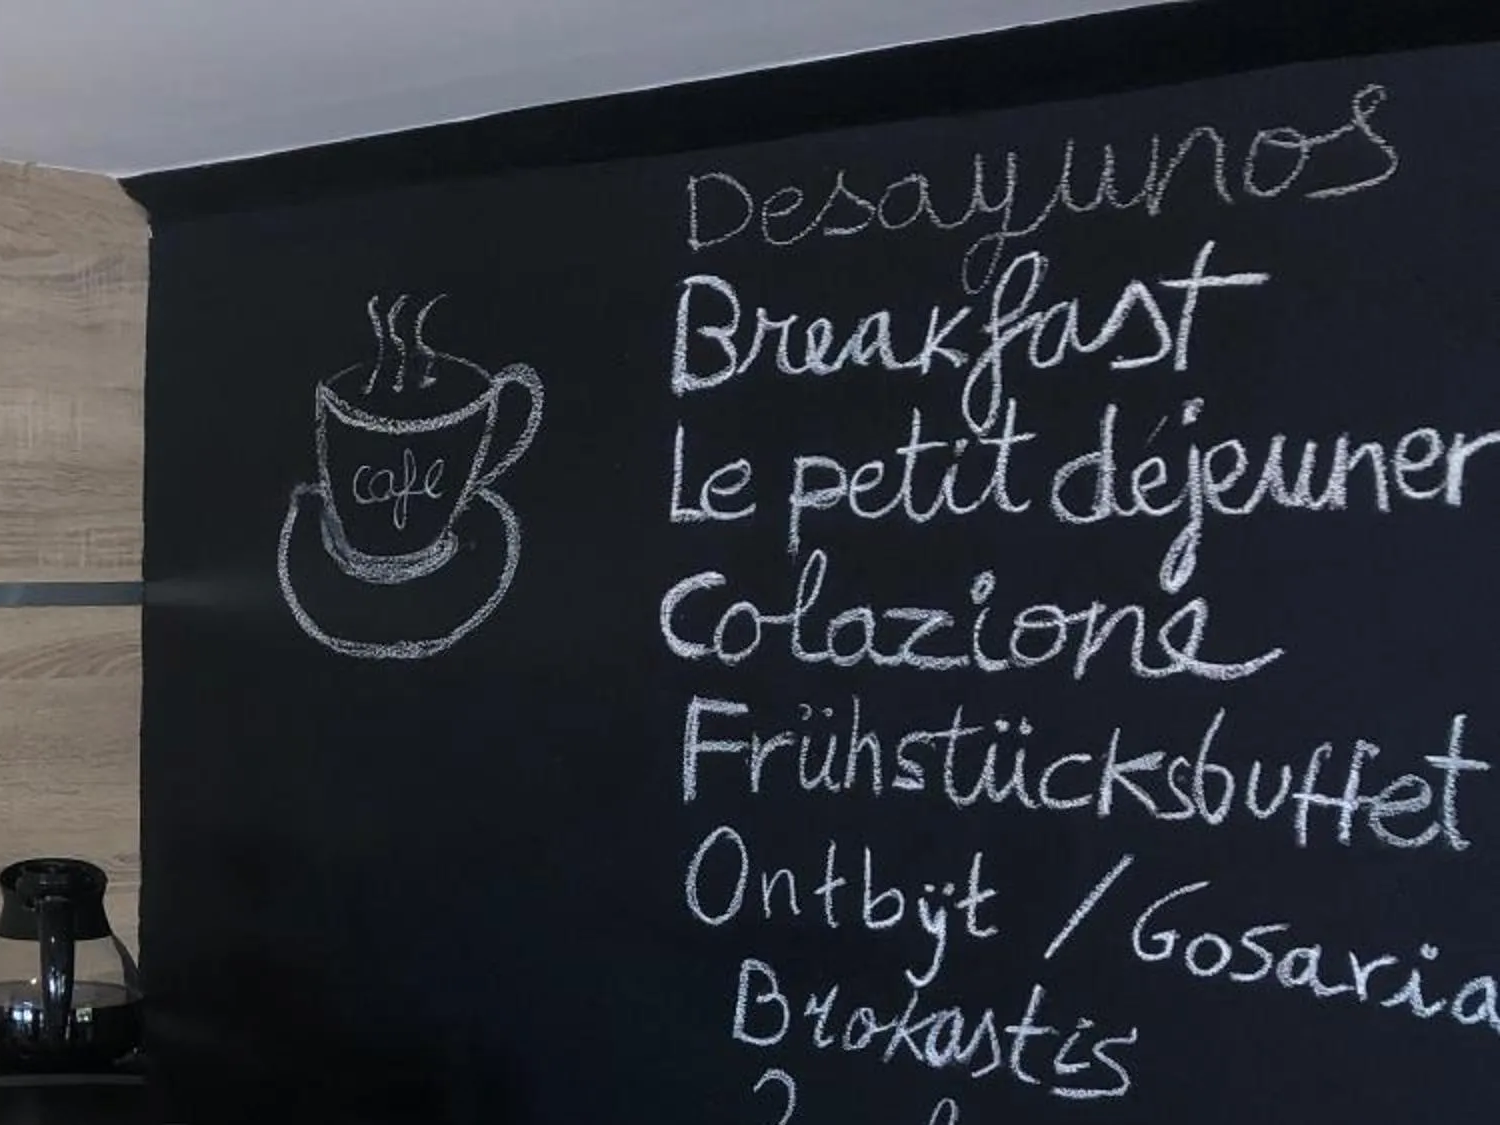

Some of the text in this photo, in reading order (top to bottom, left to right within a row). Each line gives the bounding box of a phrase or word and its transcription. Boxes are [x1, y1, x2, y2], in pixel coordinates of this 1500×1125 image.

[685, 83, 1399, 295] Desayunos
[672, 240, 1270, 436] Breakfast
[670, 397, 1500, 594] Le petit déjeuner
[660, 549, 1285, 679] Colazione
[682, 695, 1491, 851] Frühstücksbuffet
[732, 958, 1138, 1098] Brokastis
